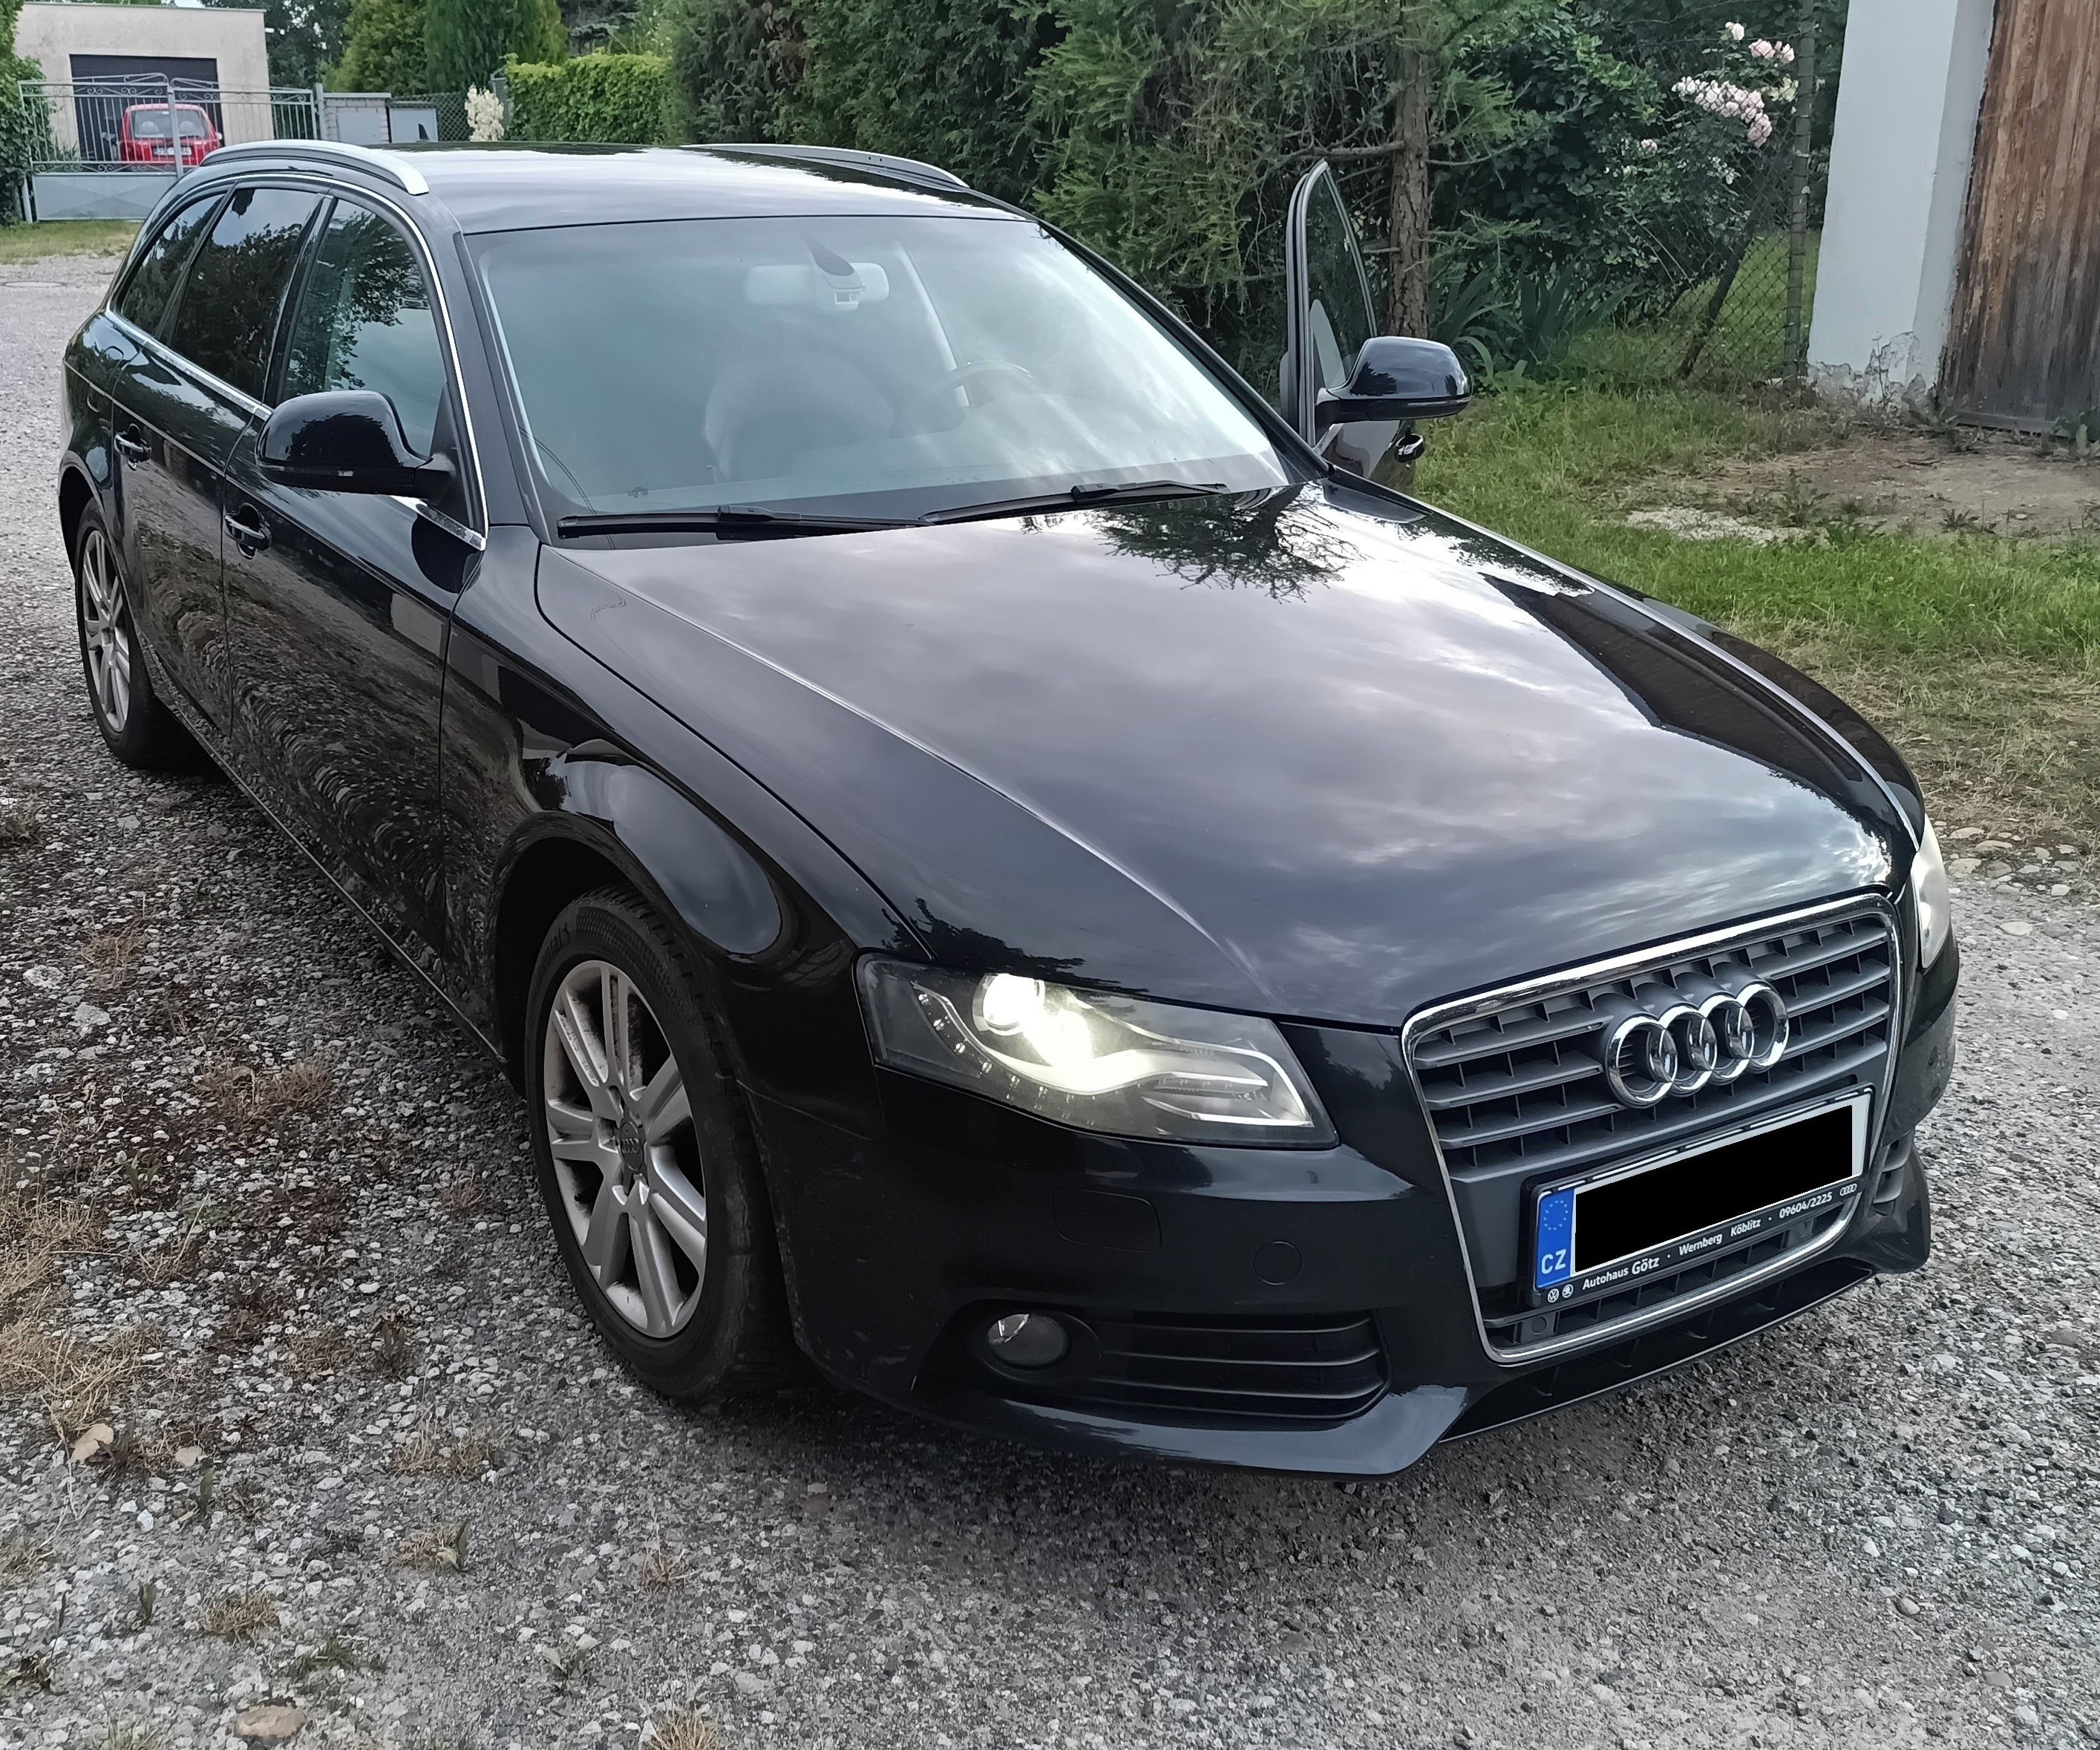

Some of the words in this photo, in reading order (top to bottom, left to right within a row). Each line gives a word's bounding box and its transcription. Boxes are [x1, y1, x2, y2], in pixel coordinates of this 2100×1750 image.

[1541, 1248, 1566, 1274] CZ
[1583, 1267, 1629, 1290] Autohaus
[1631, 1257, 1660, 1275] Götz
[1678, 1233, 1723, 1256] Wernberg
[1730, 1218, 1762, 1237] Köblitz
[1779, 1191, 1833, 1219] 09604/2225
